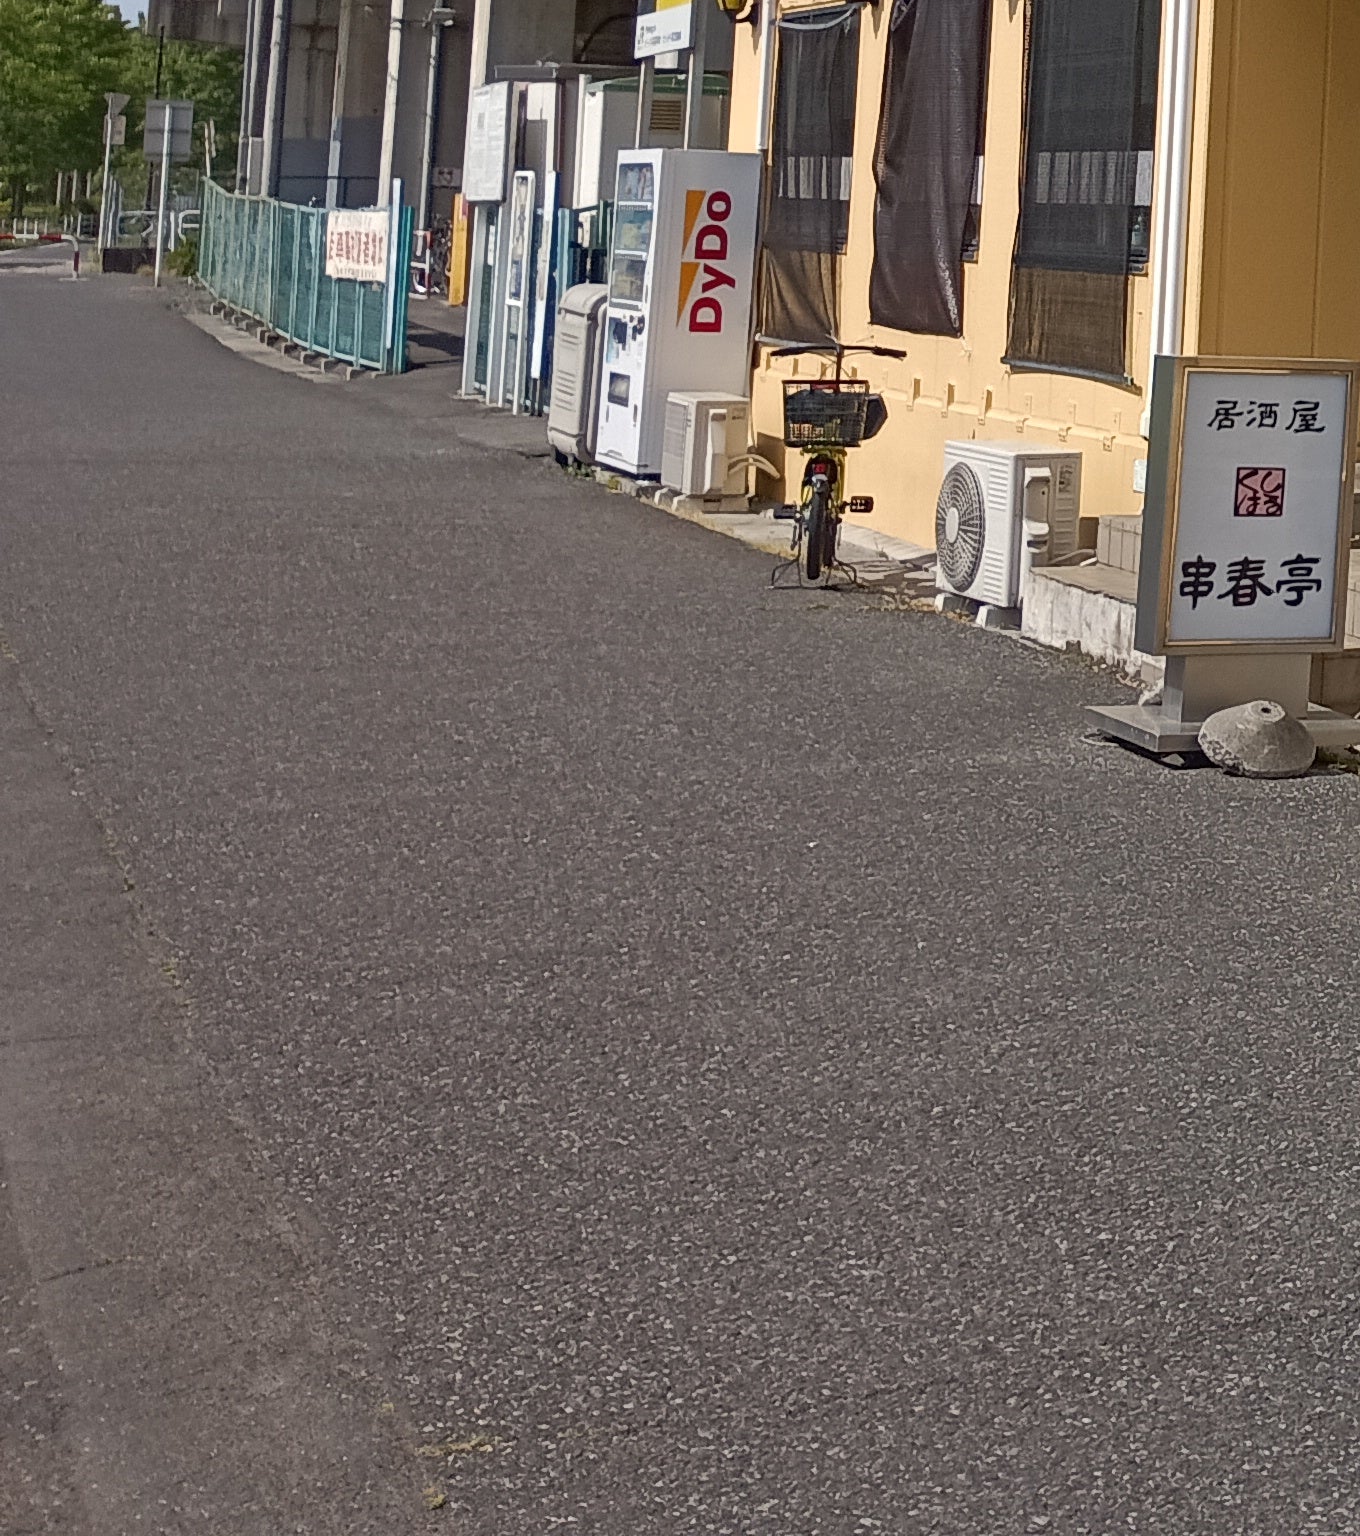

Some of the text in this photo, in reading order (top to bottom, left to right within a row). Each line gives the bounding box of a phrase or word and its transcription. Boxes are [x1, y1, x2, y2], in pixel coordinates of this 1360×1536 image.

[688, 190, 736, 333] DyDo
[1207, 400, 1325, 434] 居酒屋
[1179, 553, 1322, 611] 串春亭
